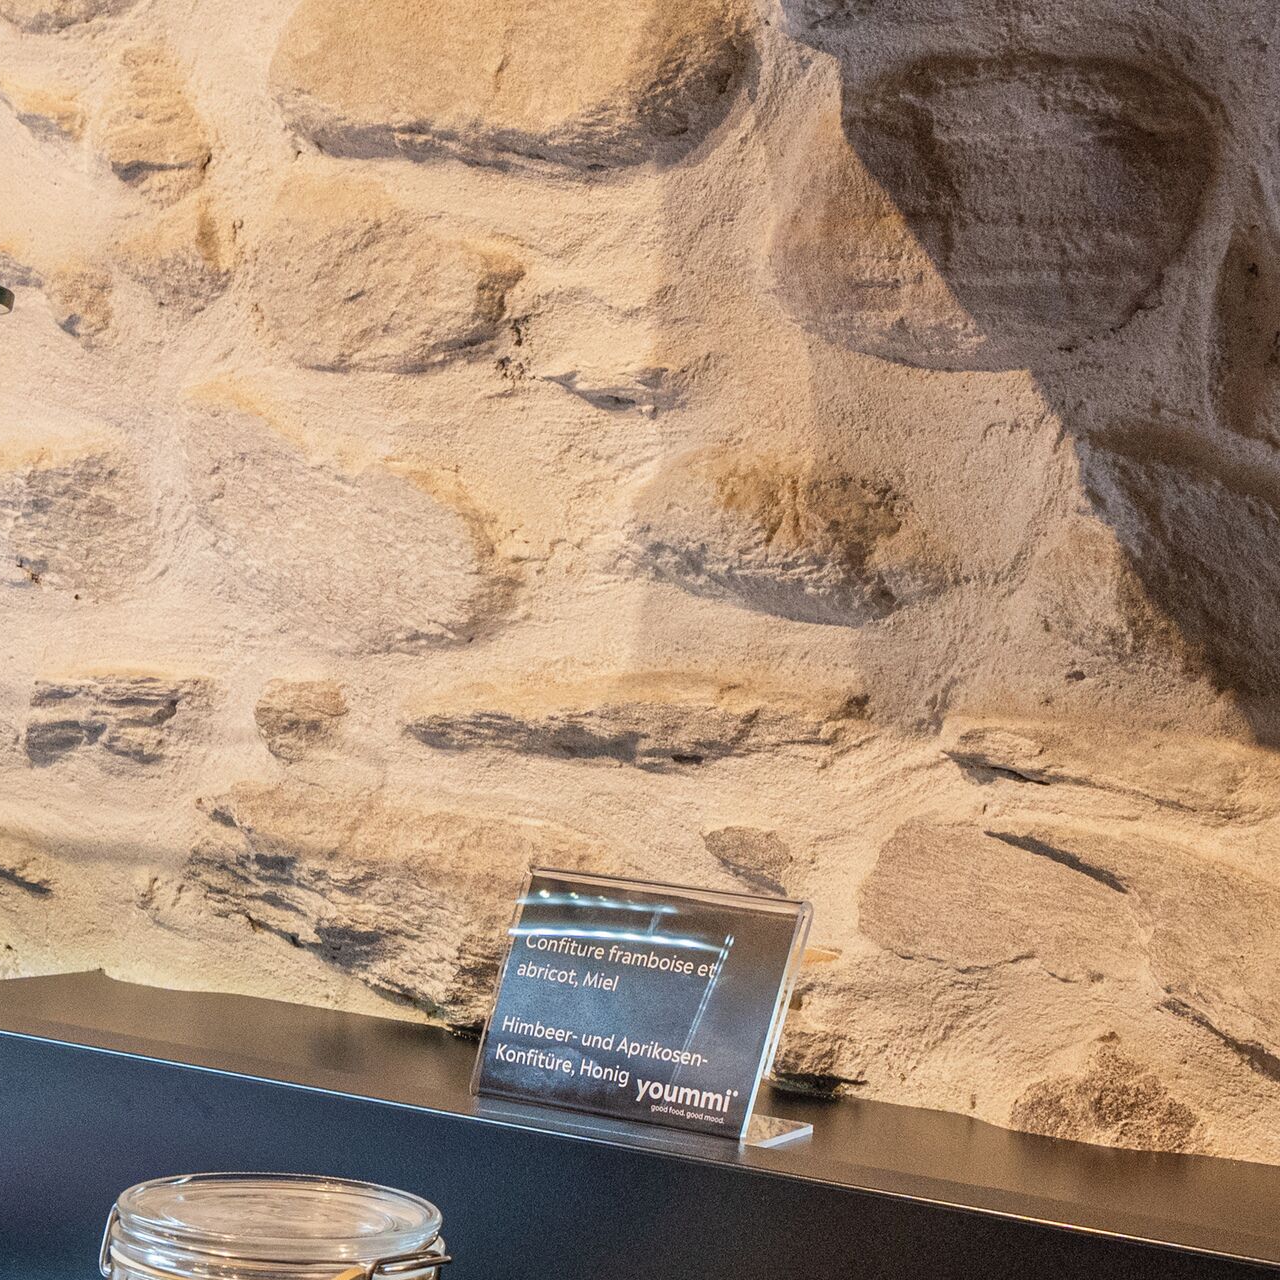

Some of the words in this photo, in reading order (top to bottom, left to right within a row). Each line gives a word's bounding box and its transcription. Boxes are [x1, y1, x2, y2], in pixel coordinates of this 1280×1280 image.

[516, 960, 579, 987] abricot,
[582, 971, 620, 992] Miel
[525, 933, 605, 960] Confiture
[608, 945, 694, 975] framboise
[697, 961, 717, 979] et
[501, 1015, 578, 1042] Himbeer-
[581, 1032, 615, 1051] und
[616, 1036, 709, 1068] Aprikosen-
[495, 1043, 576, 1077] Konfitüre,
[579, 1059, 630, 1088] Honig
[635, 1078, 738, 1113] yoummi
[650, 1103, 669, 1114] good
[668, 1105, 686, 1117] food.
[686, 1110, 704, 1120] good
[704, 1112, 725, 1124] mood.
